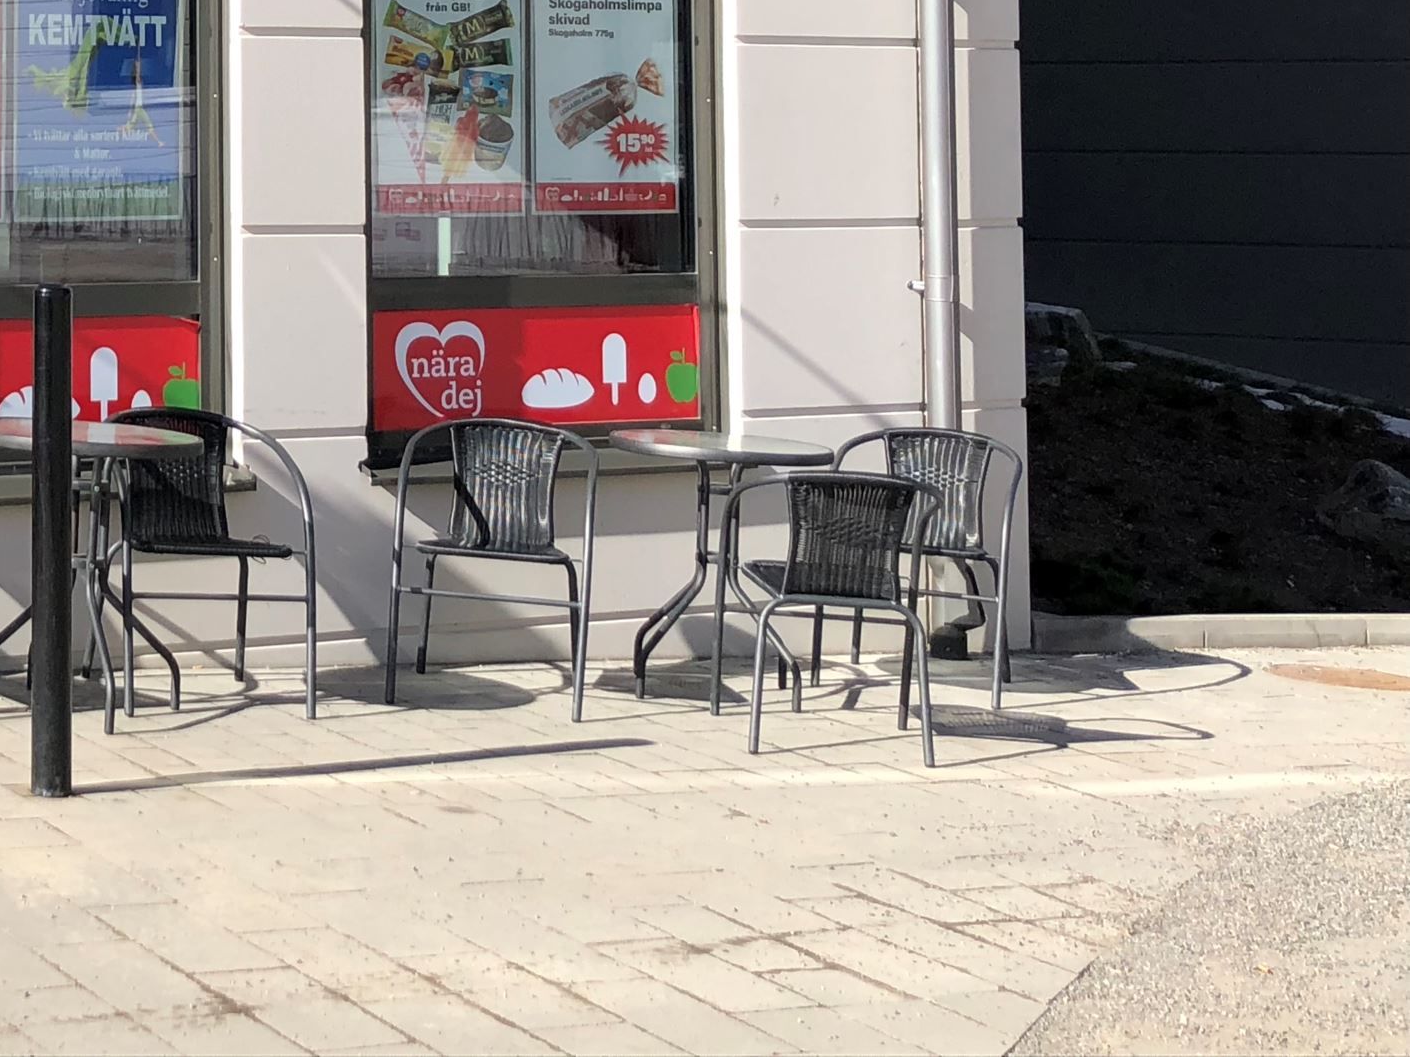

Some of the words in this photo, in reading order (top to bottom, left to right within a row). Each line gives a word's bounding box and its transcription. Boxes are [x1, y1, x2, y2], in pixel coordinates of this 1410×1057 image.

[426, 2, 447, 12] från
[451, 2, 471, 12] GB!
[28, 8, 167, 47] KEMTVÄTT
[548, 13, 590, 25] skivad
[548, 28, 592, 38] Skogaholm
[411, 349, 475, 378] nära
[441, 380, 482, 418] dej
